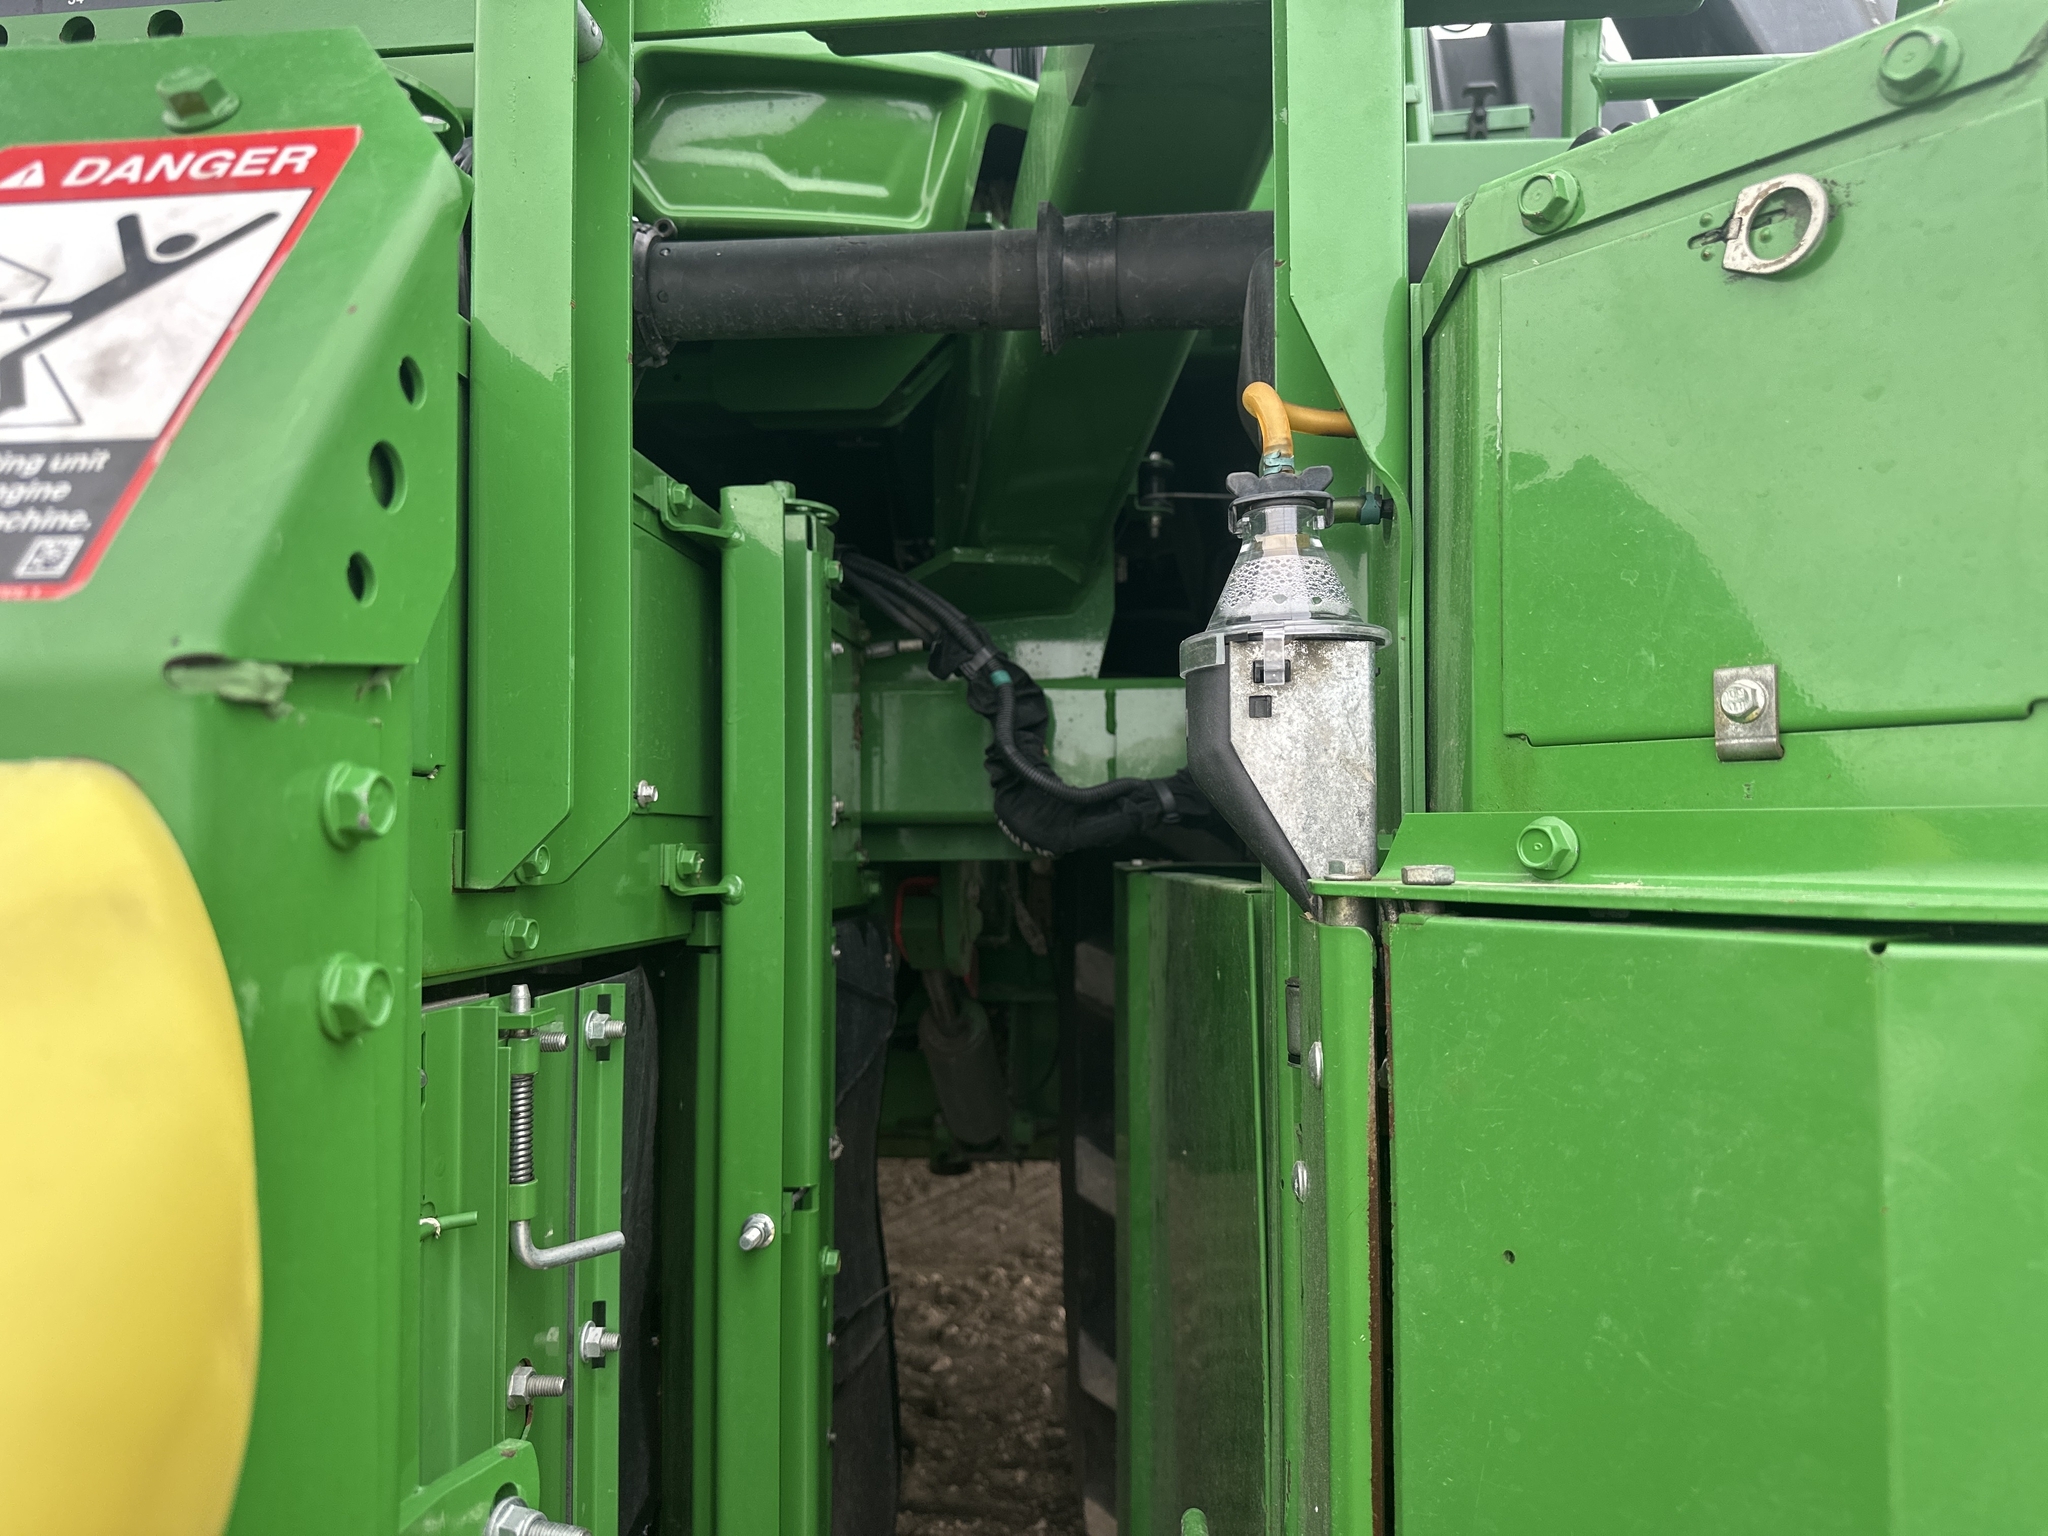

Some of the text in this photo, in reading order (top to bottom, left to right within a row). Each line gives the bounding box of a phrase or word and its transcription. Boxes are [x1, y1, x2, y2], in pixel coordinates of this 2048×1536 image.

[61, 144, 318, 187] DANGER
[0, 447, 111, 480] ing unit
[0, 505, 92, 533] chine.
